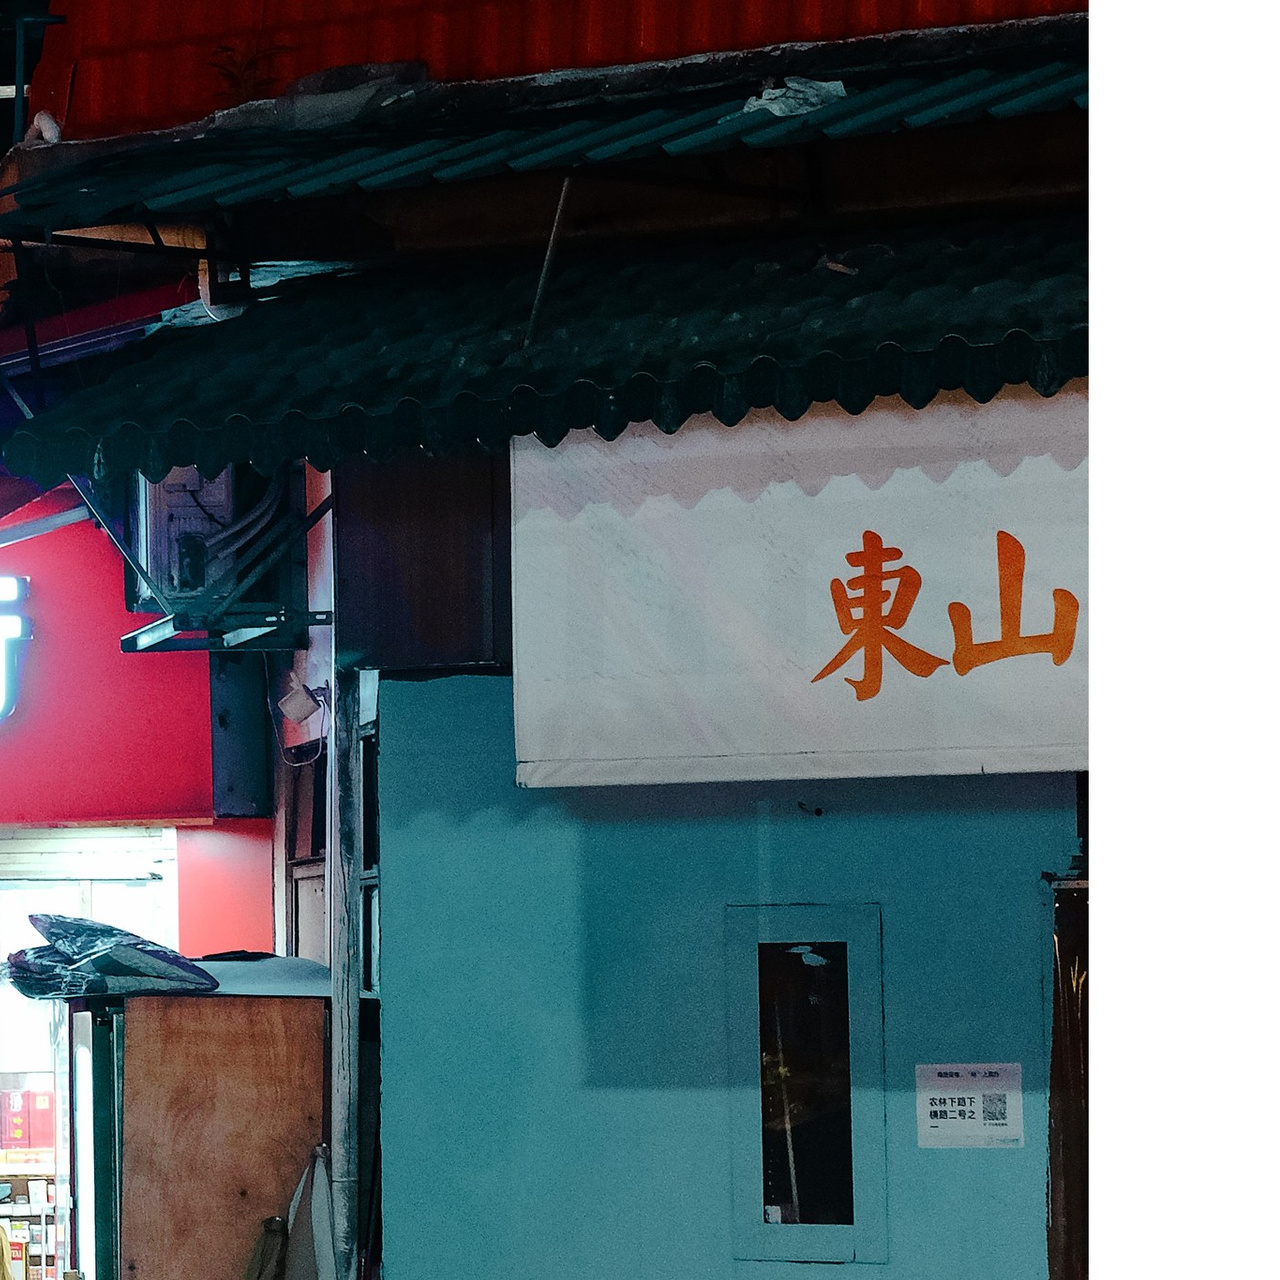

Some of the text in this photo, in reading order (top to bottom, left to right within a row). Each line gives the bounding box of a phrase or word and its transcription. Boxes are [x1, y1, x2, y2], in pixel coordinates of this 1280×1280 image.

[811, 529, 1081, 702] 東山
[928, 1096, 977, 1108] 农林下路下
